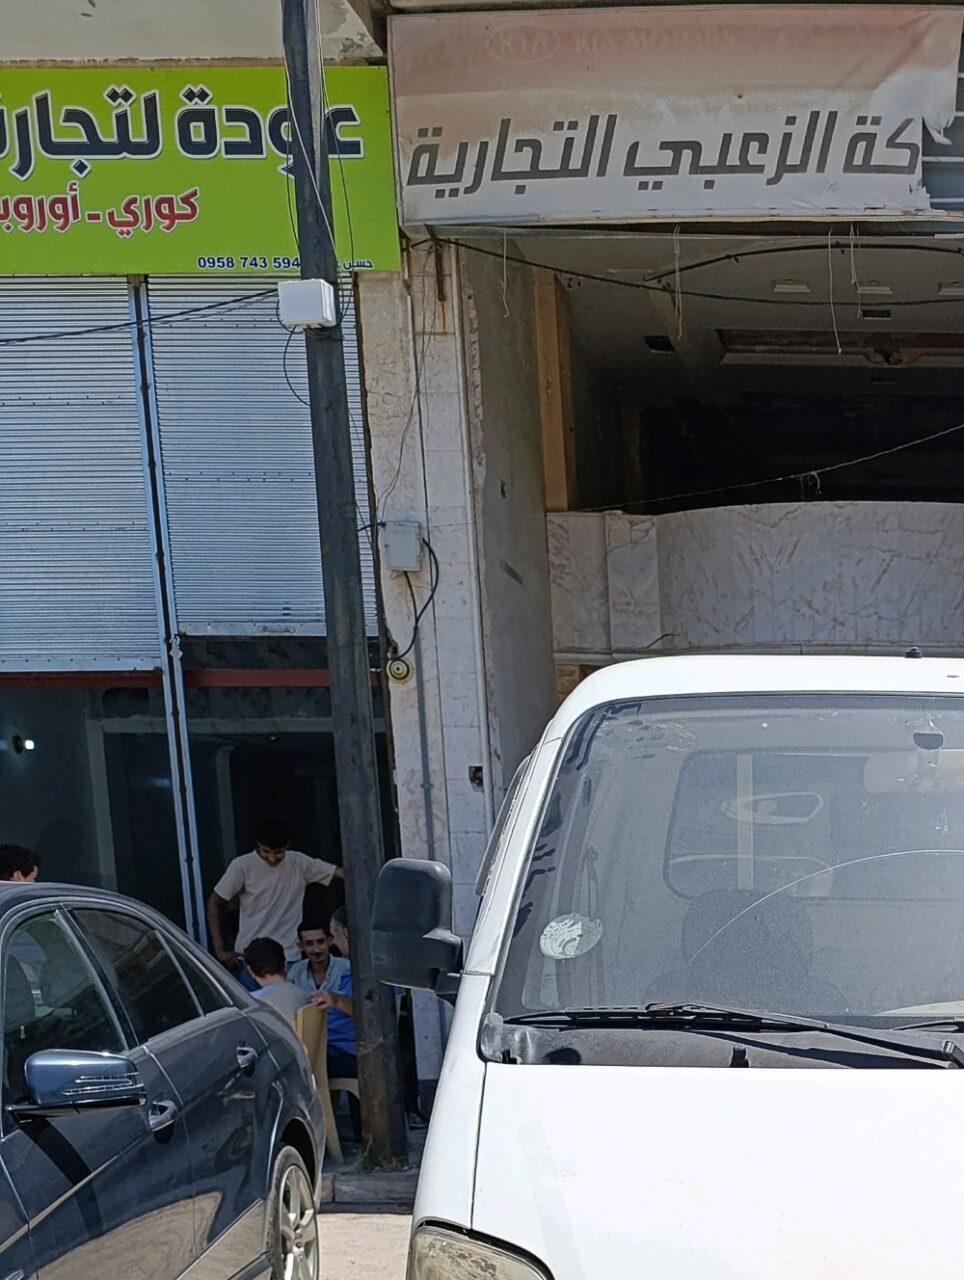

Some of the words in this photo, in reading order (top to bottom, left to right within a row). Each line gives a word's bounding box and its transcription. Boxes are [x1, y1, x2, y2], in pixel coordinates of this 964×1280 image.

[0, 84, 162, 181] لتجار
[406, 114, 618, 200] التجارية
[622, 110, 839, 190] الزعبي
[842, 115, 920, 175] كة
[197, 256, 235, 269] 0958
[240, 256, 268, 269] 743
[272, 256, 301, 269] 594
